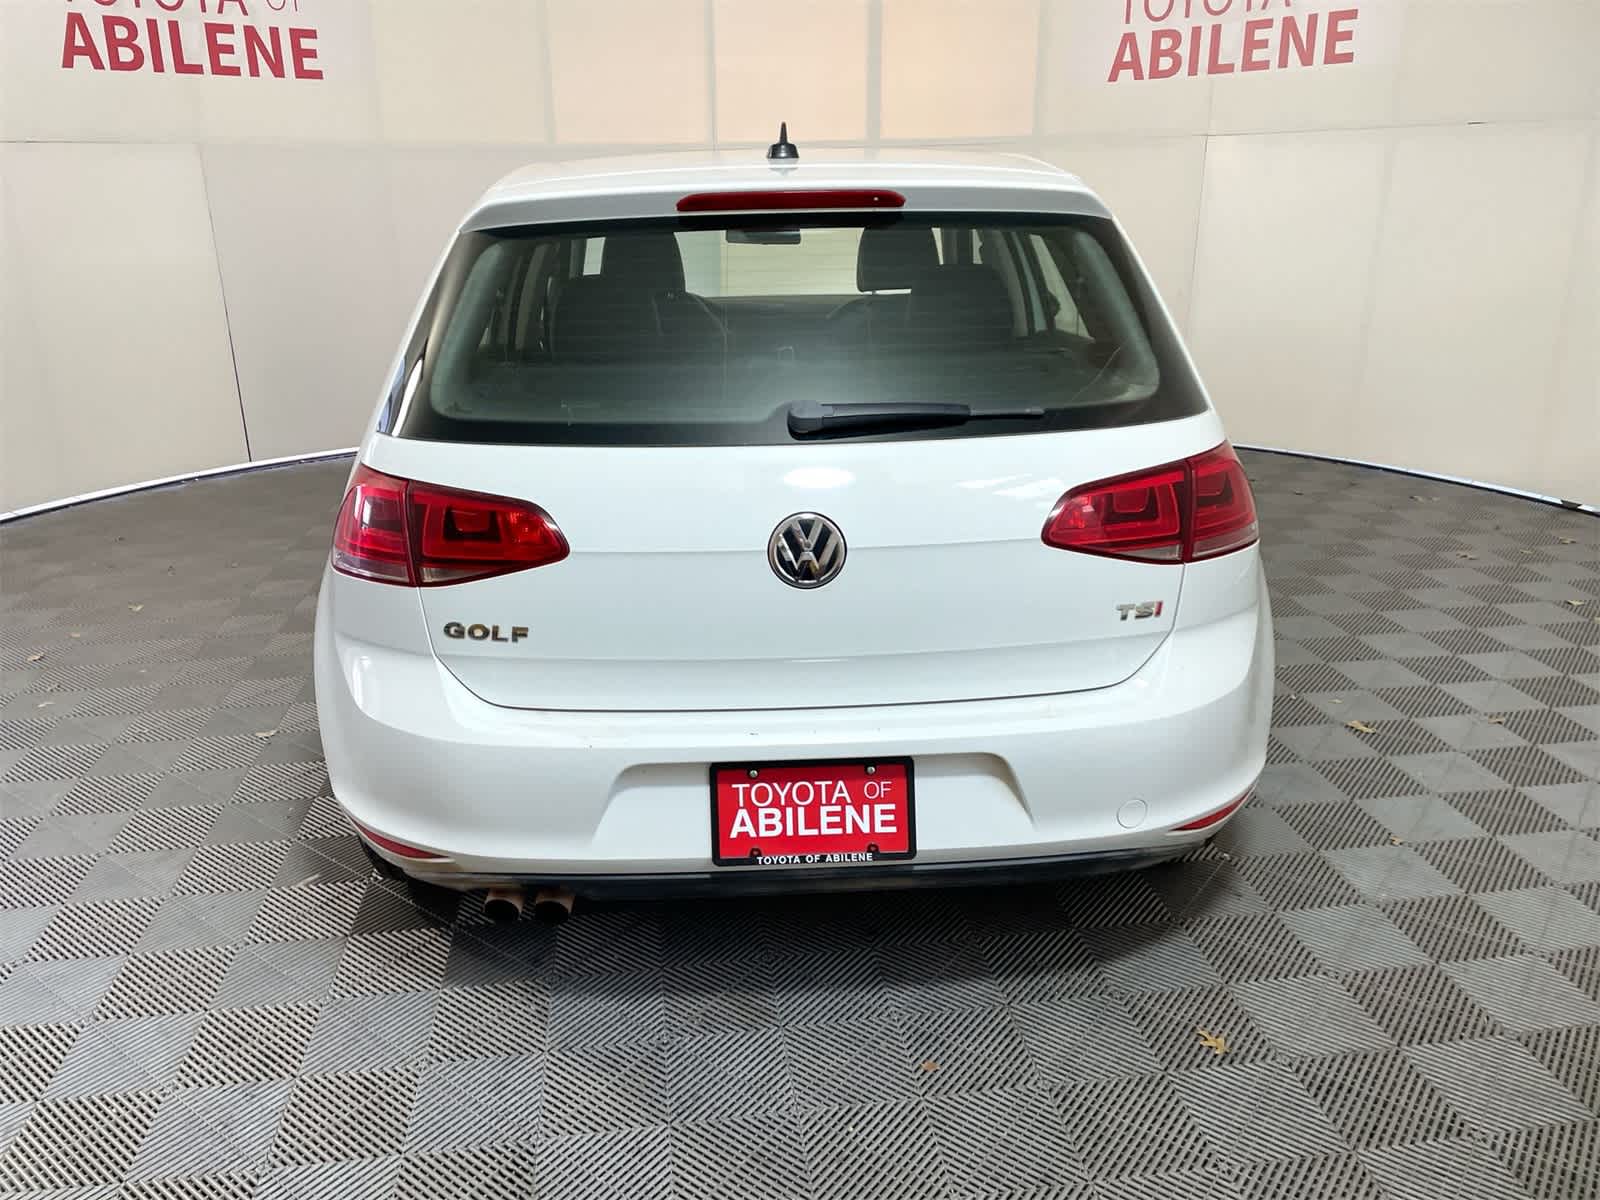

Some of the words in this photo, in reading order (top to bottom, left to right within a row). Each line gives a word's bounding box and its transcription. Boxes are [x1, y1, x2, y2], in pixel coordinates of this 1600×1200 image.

[62, 12, 324, 80] ABILENE
[1107, 8, 1359, 82] ABILENE
[1115, 600, 1164, 621] TSI
[443, 621, 529, 643] GOLF
[731, 780, 851, 807] TOYOTA
[863, 781, 892, 799] OF
[729, 803, 897, 839] ABILENE
[756, 855, 801, 865] TOYOTA
[805, 854, 820, 863] OF
[825, 853, 873, 863] ABILENE
